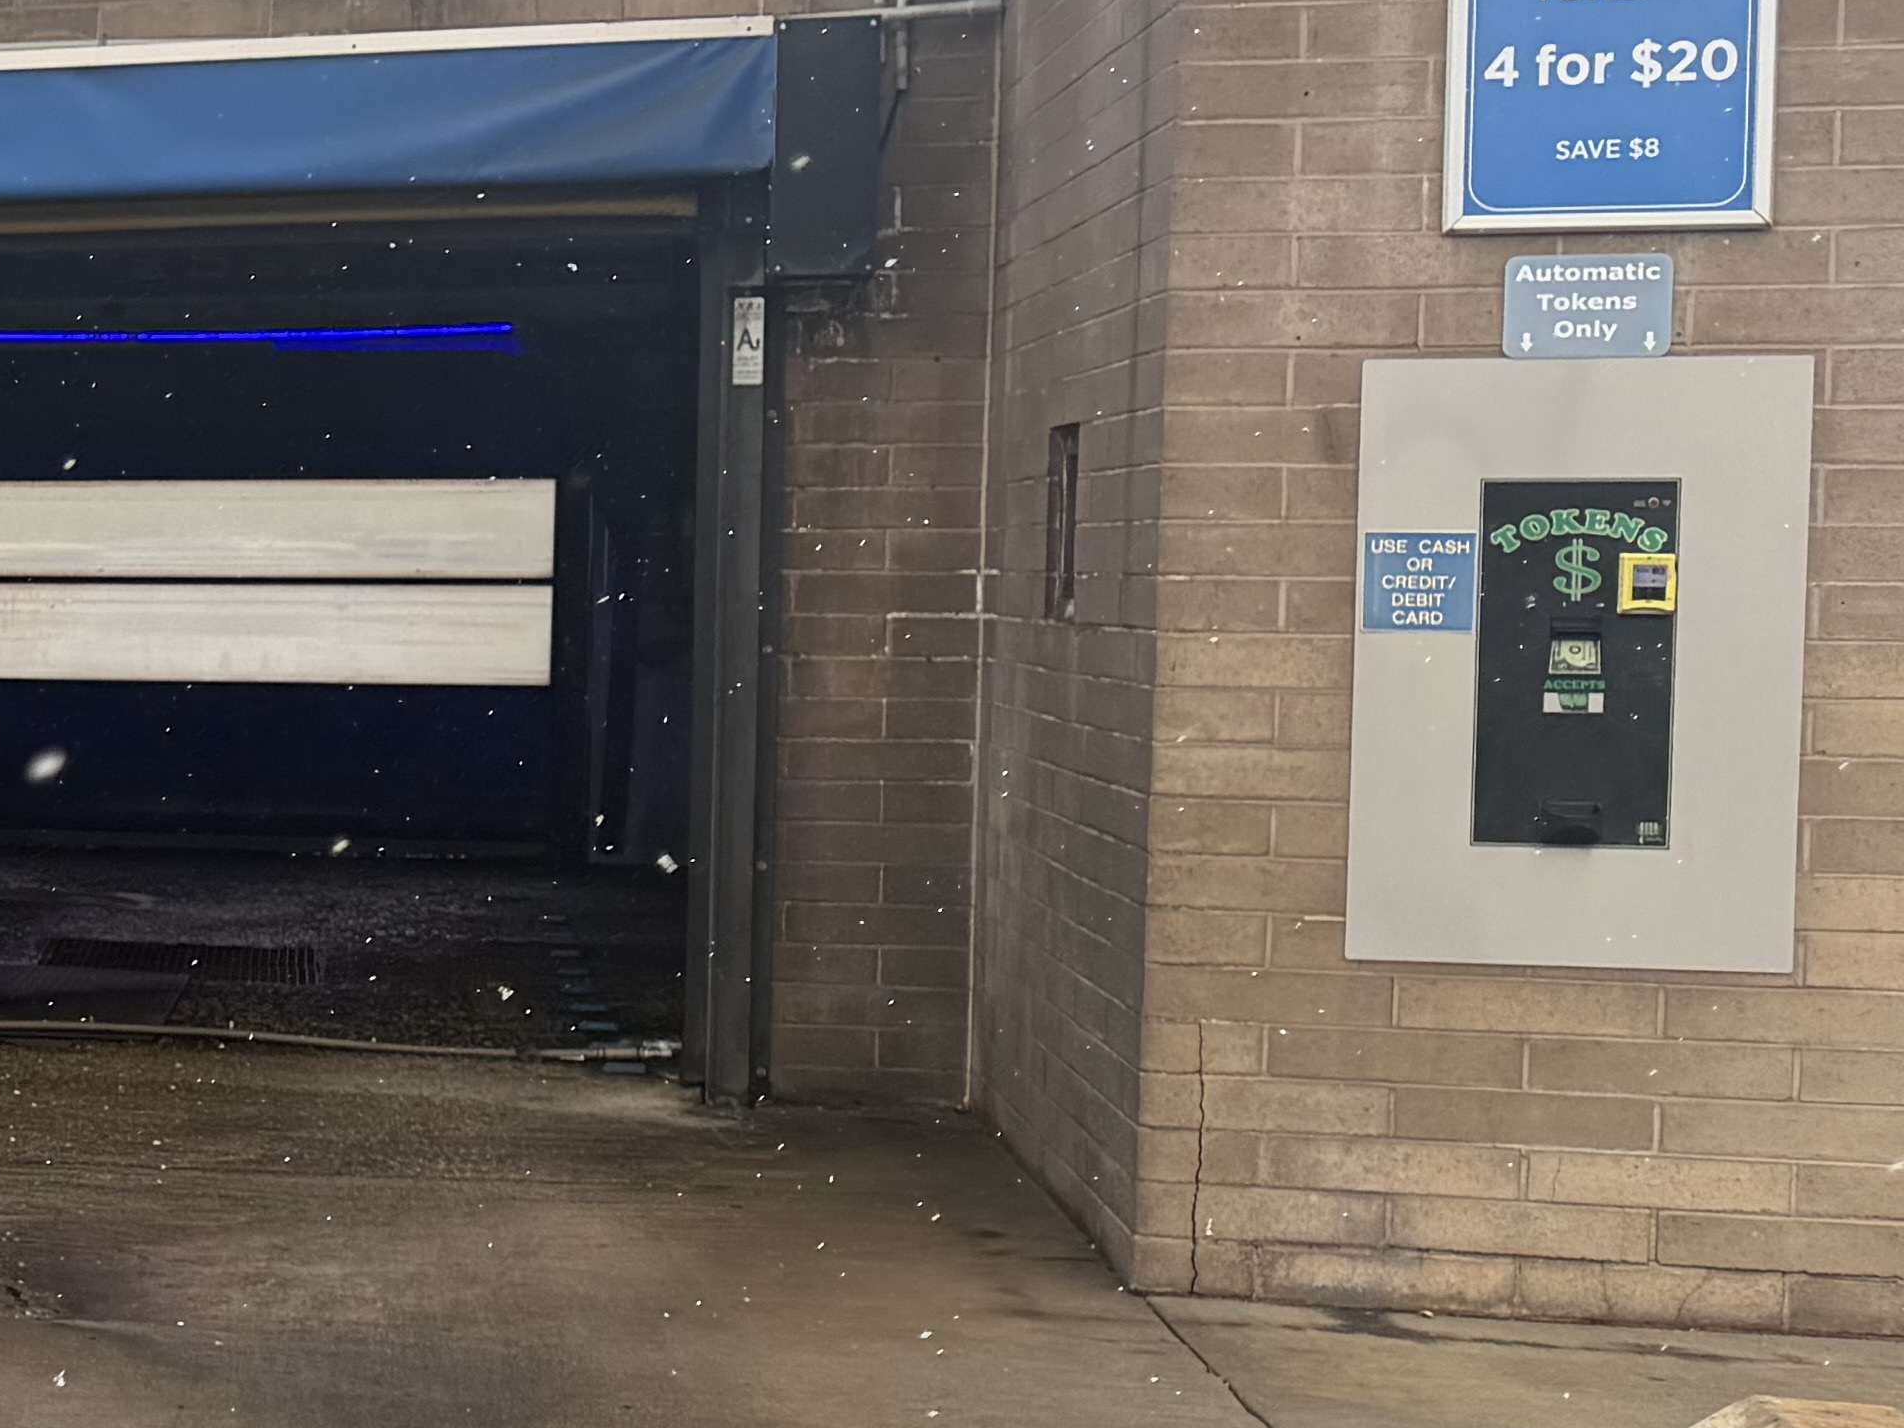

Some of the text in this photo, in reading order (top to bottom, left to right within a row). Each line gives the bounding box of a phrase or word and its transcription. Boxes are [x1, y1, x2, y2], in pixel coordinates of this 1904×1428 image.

[1483, 38, 1739, 88] 4 for $20
[1555, 137, 1660, 160] SAVE $8
[1515, 261, 1661, 282] Automatic
[1536, 292, 1638, 311] Tokens
[1553, 319, 1618, 342] Only
[1490, 508, 1669, 553] TOKENS
[1371, 539, 1470, 554] USE CASH
[1406, 557, 1433, 572] OR
[1381, 574, 1456, 589] CREDIT/
[1392, 593, 1445, 607] DEBIT
[1392, 610, 1443, 625] CARD
[1544, 679, 1605, 691] ACCEPTS
